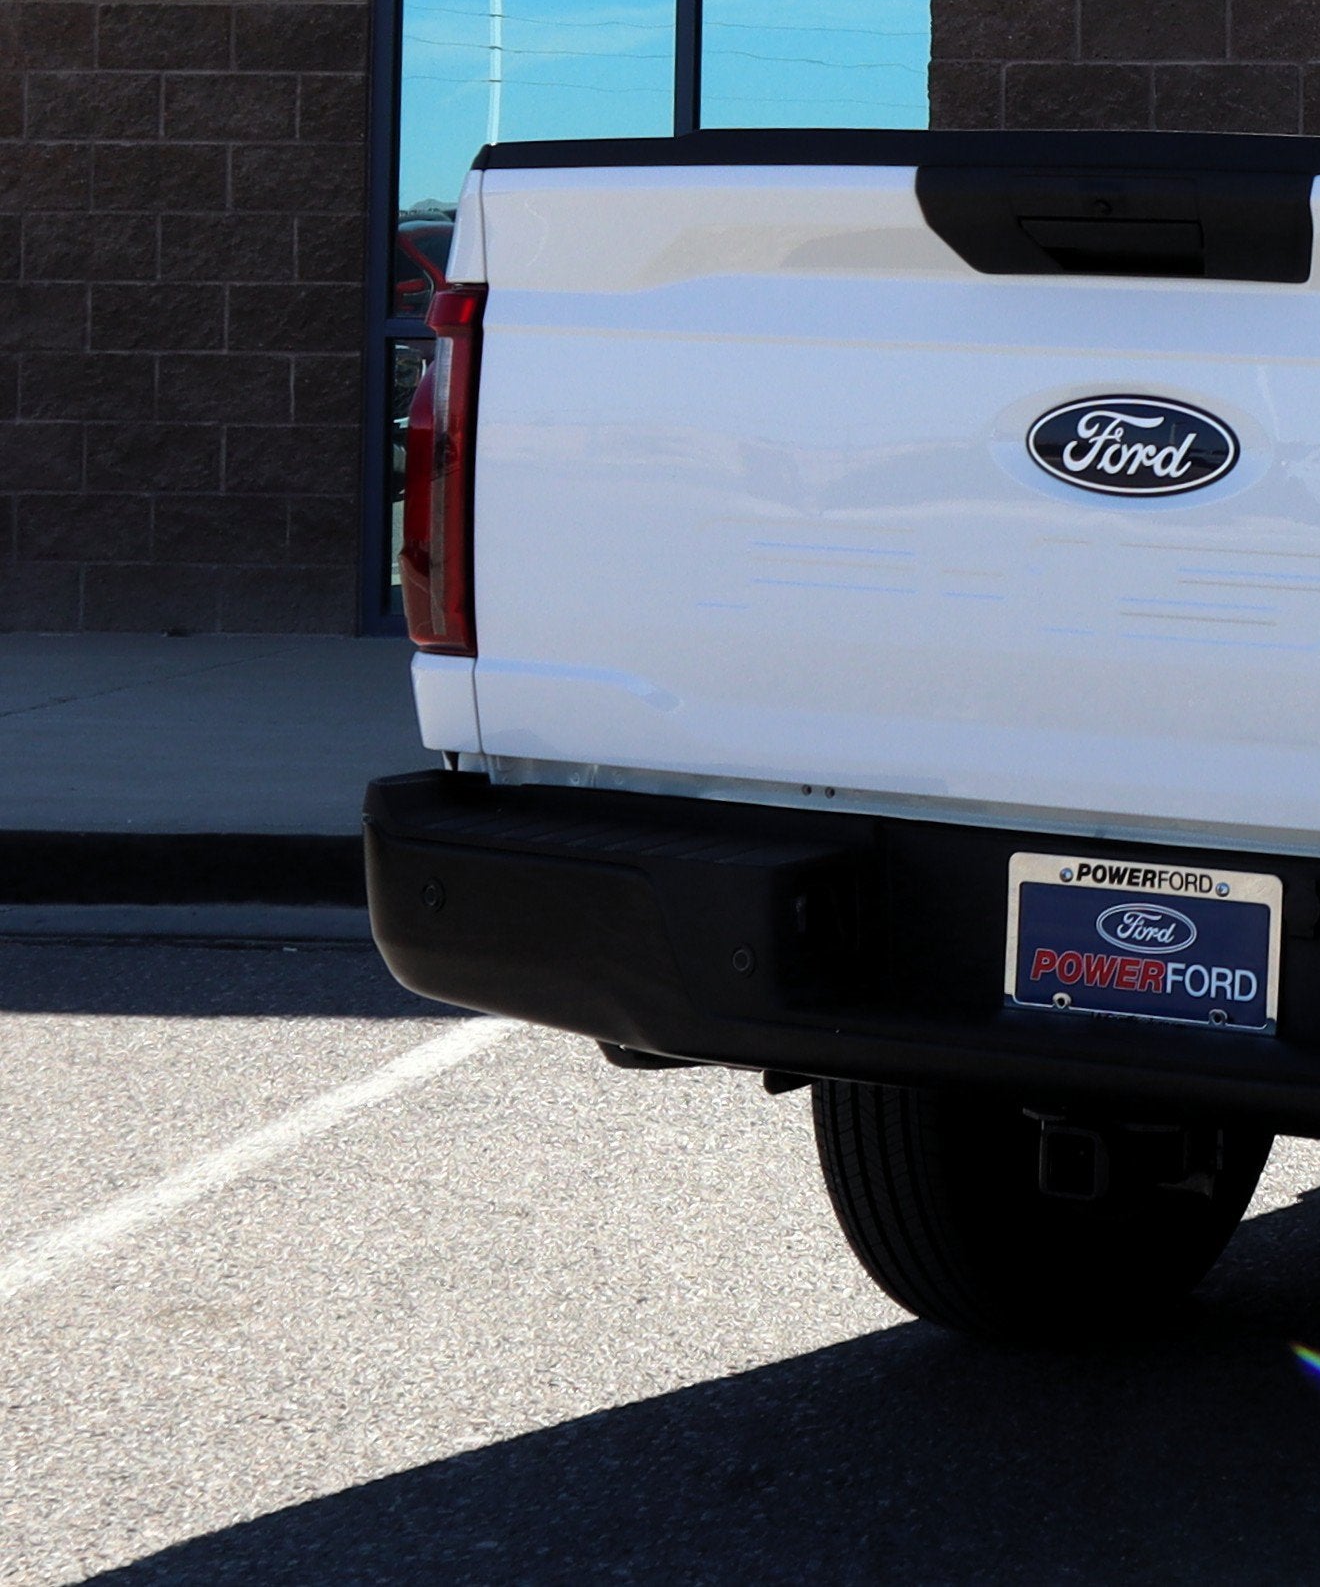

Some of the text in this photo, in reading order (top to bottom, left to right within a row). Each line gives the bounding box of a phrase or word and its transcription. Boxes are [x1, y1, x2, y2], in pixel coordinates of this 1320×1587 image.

[1062, 410, 1198, 478] Ford
[1076, 863, 1213, 894] POWERFORD
[1116, 911, 1177, 944] Ford
[1030, 948, 1258, 1001] POWERFORD
